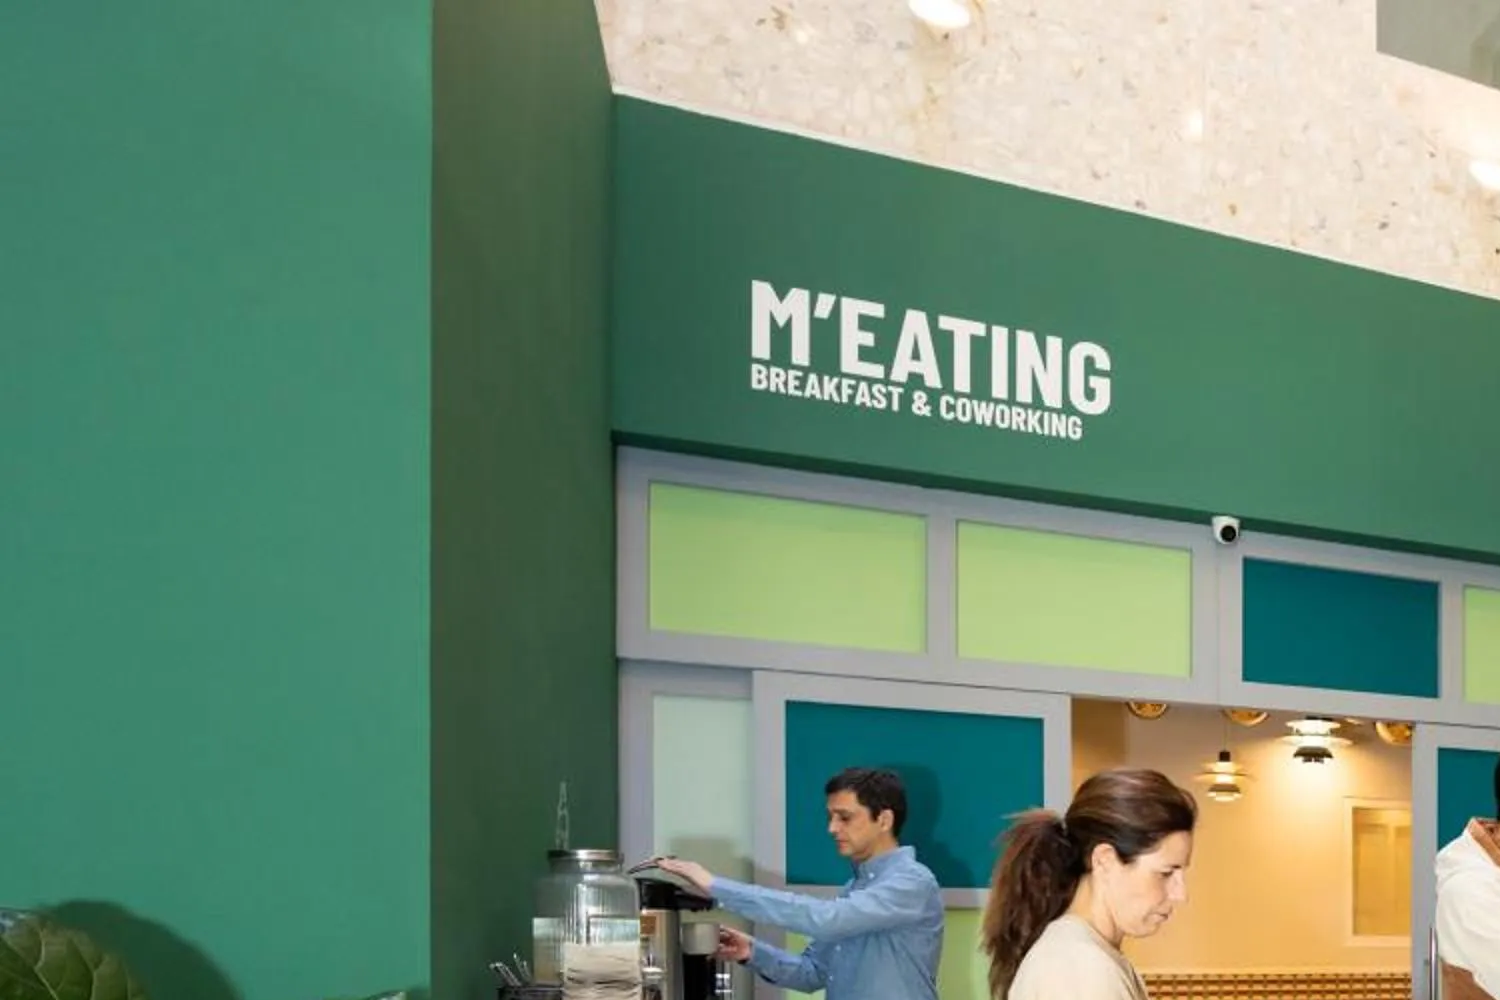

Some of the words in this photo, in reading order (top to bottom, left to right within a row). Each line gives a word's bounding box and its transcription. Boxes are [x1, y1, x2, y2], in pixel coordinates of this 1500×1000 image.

[751, 363, 904, 412] BREAKFAST
[911, 390, 932, 417] &
[939, 394, 1083, 441] COWORKING
